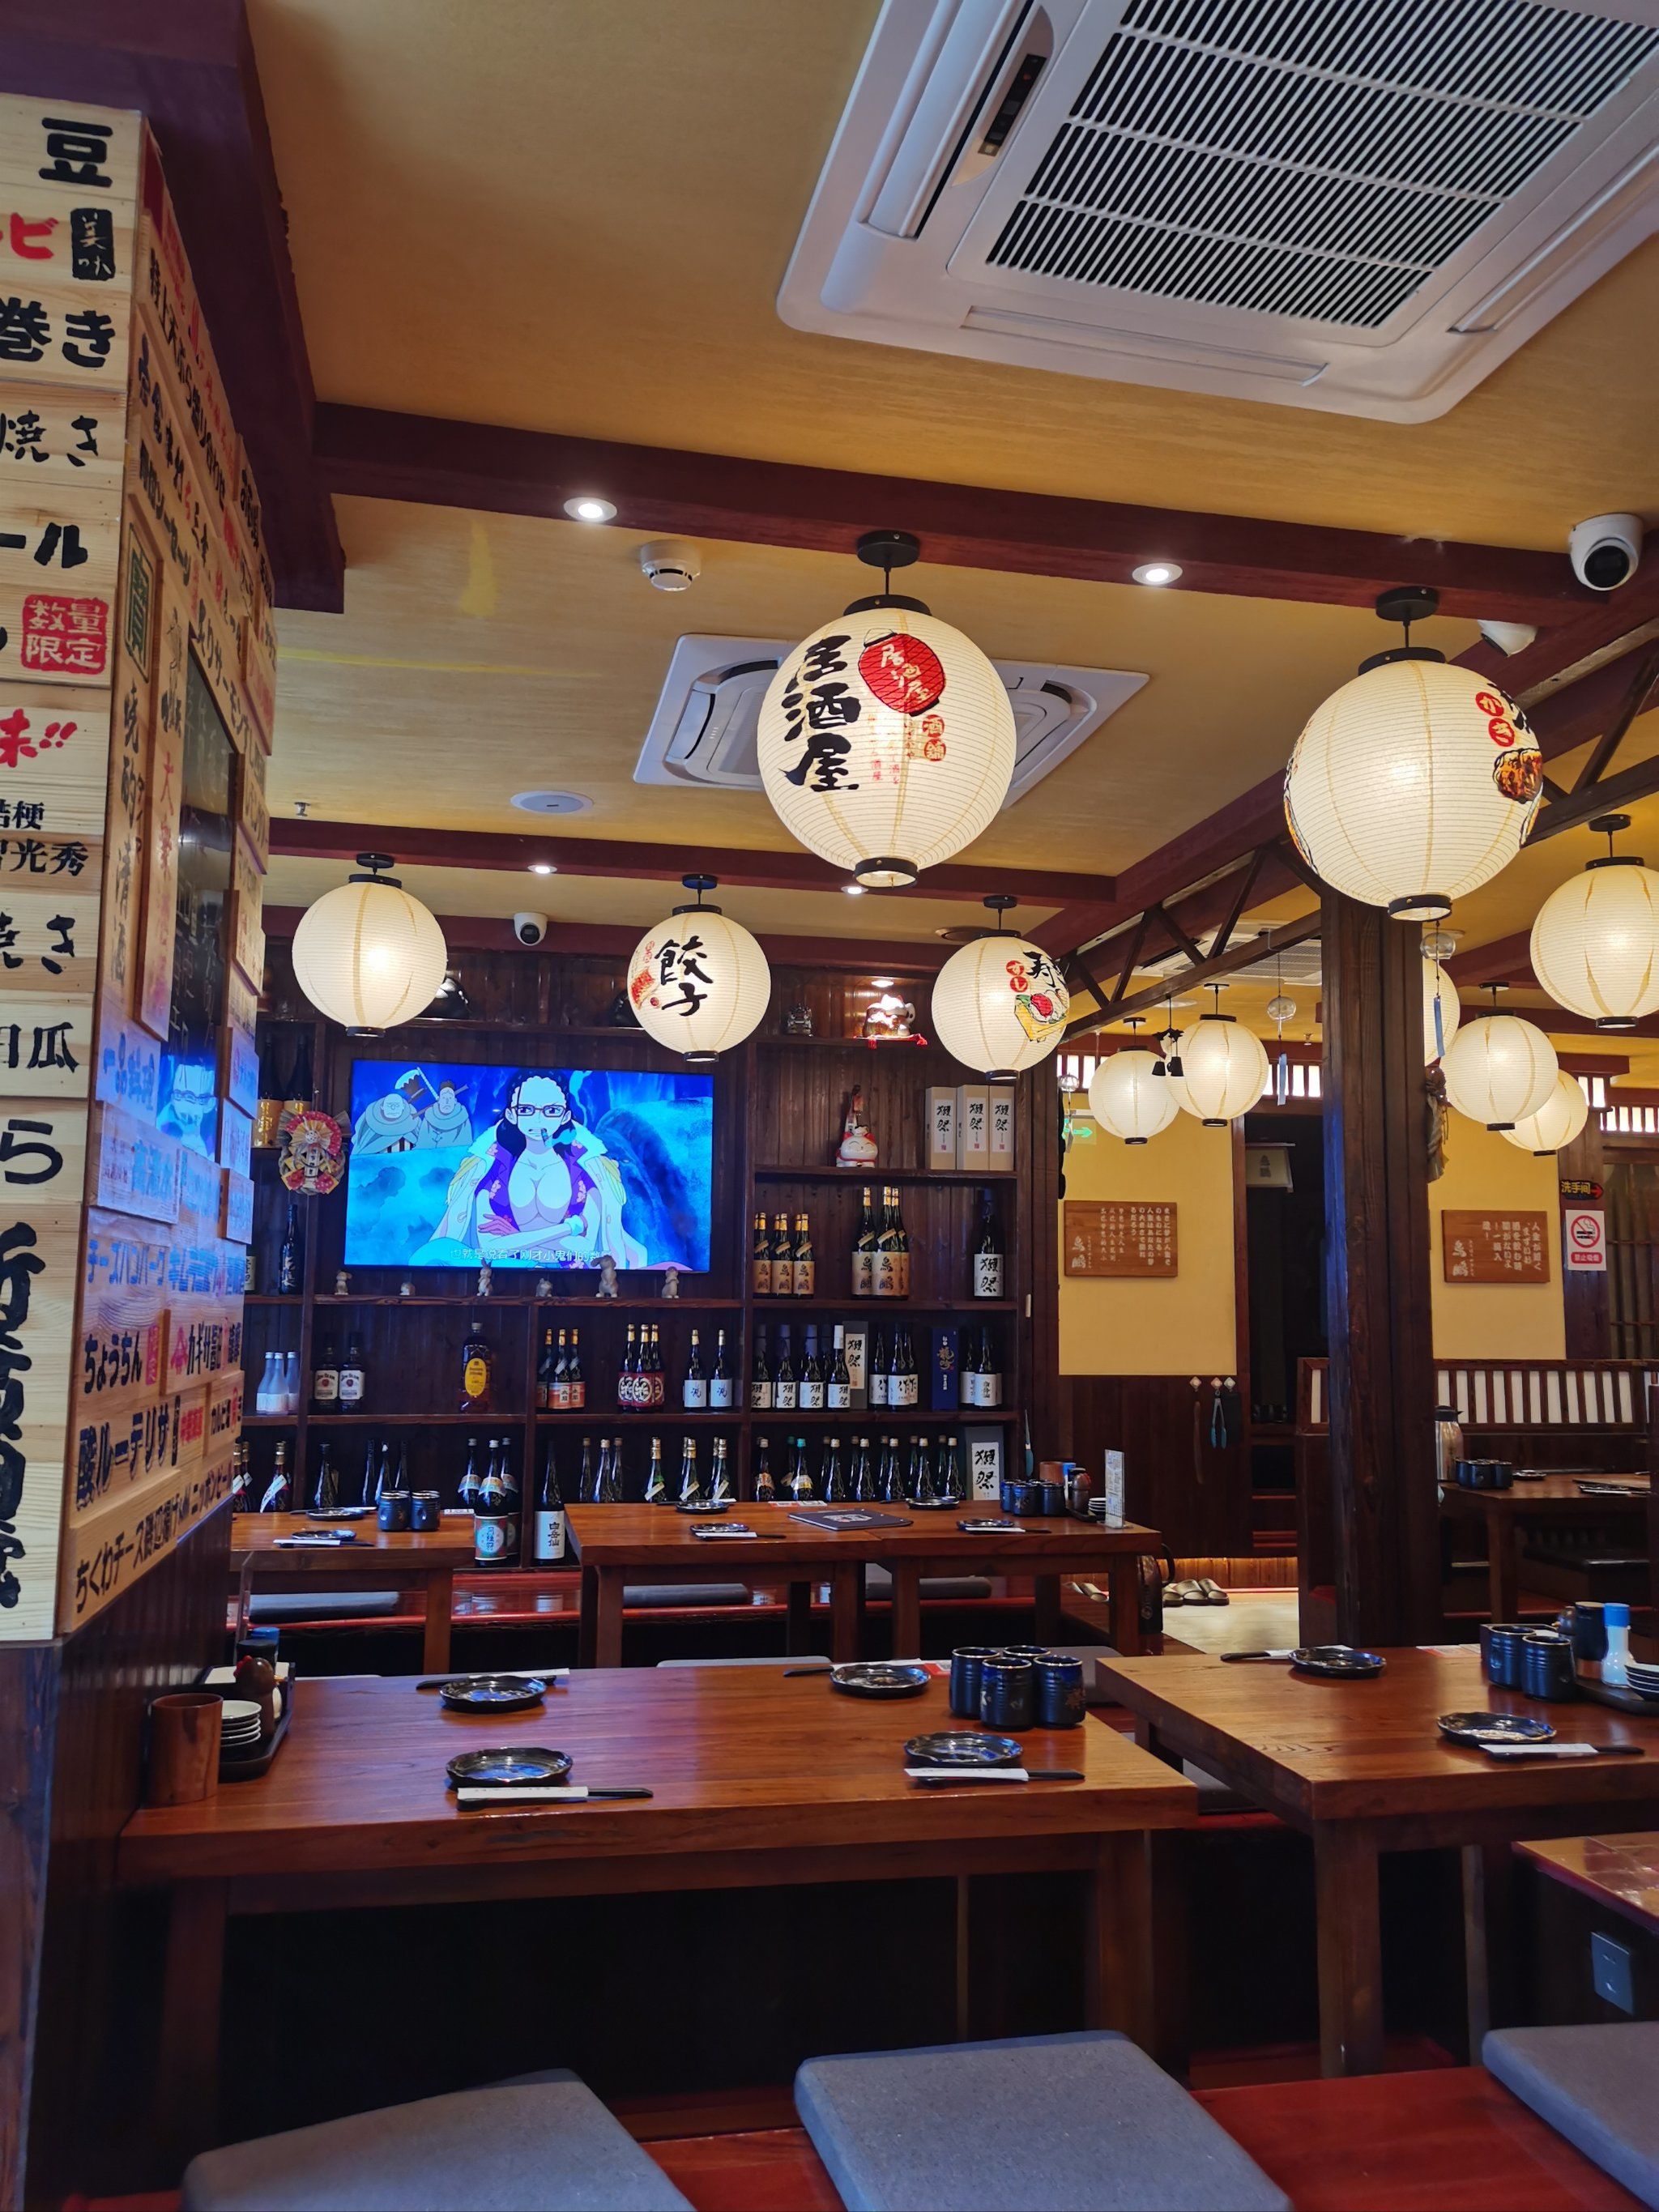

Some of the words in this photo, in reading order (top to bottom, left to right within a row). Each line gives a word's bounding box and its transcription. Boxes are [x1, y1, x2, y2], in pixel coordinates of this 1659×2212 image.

[39, 117, 114, 187] 豆
[0, 296, 116, 368] 巻き
[30, 601, 102, 636] 数量
[26, 634, 102, 669] 限定
[881, 644, 934, 704] 居酒屋
[778, 635, 861, 792] 居酒屋
[655, 936, 714, 1016] 餃子
[1561, 1181, 1591, 1195] 洗手间
[980, 1257, 999, 1293] 獺祭
[84, 1330, 143, 1394] ちょうちん
[975, 1449, 996, 1490] 獺祭
[548, 1521, 561, 1547] 白岳仙
